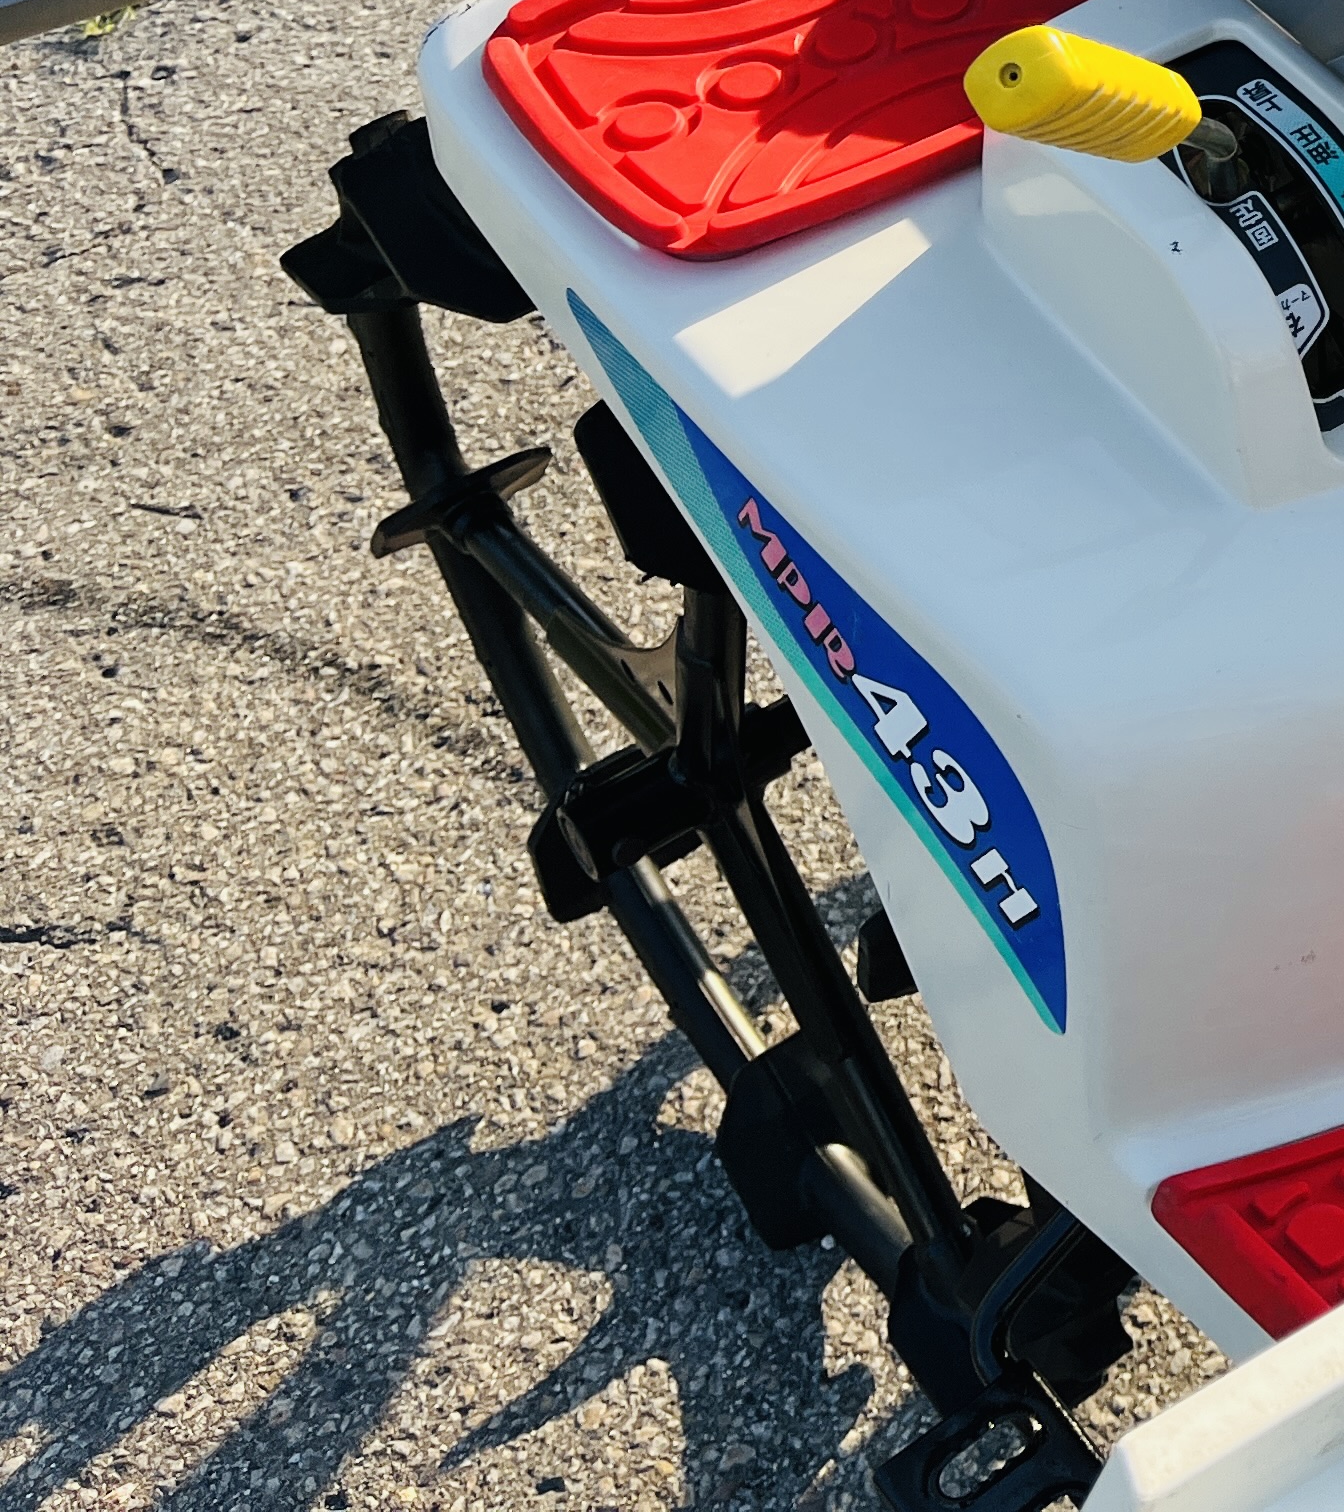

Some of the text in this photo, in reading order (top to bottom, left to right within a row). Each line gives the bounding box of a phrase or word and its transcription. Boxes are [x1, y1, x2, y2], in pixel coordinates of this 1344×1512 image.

[1242, 80, 1283, 112] 上昇
[1290, 123, 1339, 166] 油圧
[1230, 199, 1279, 251] 固定
